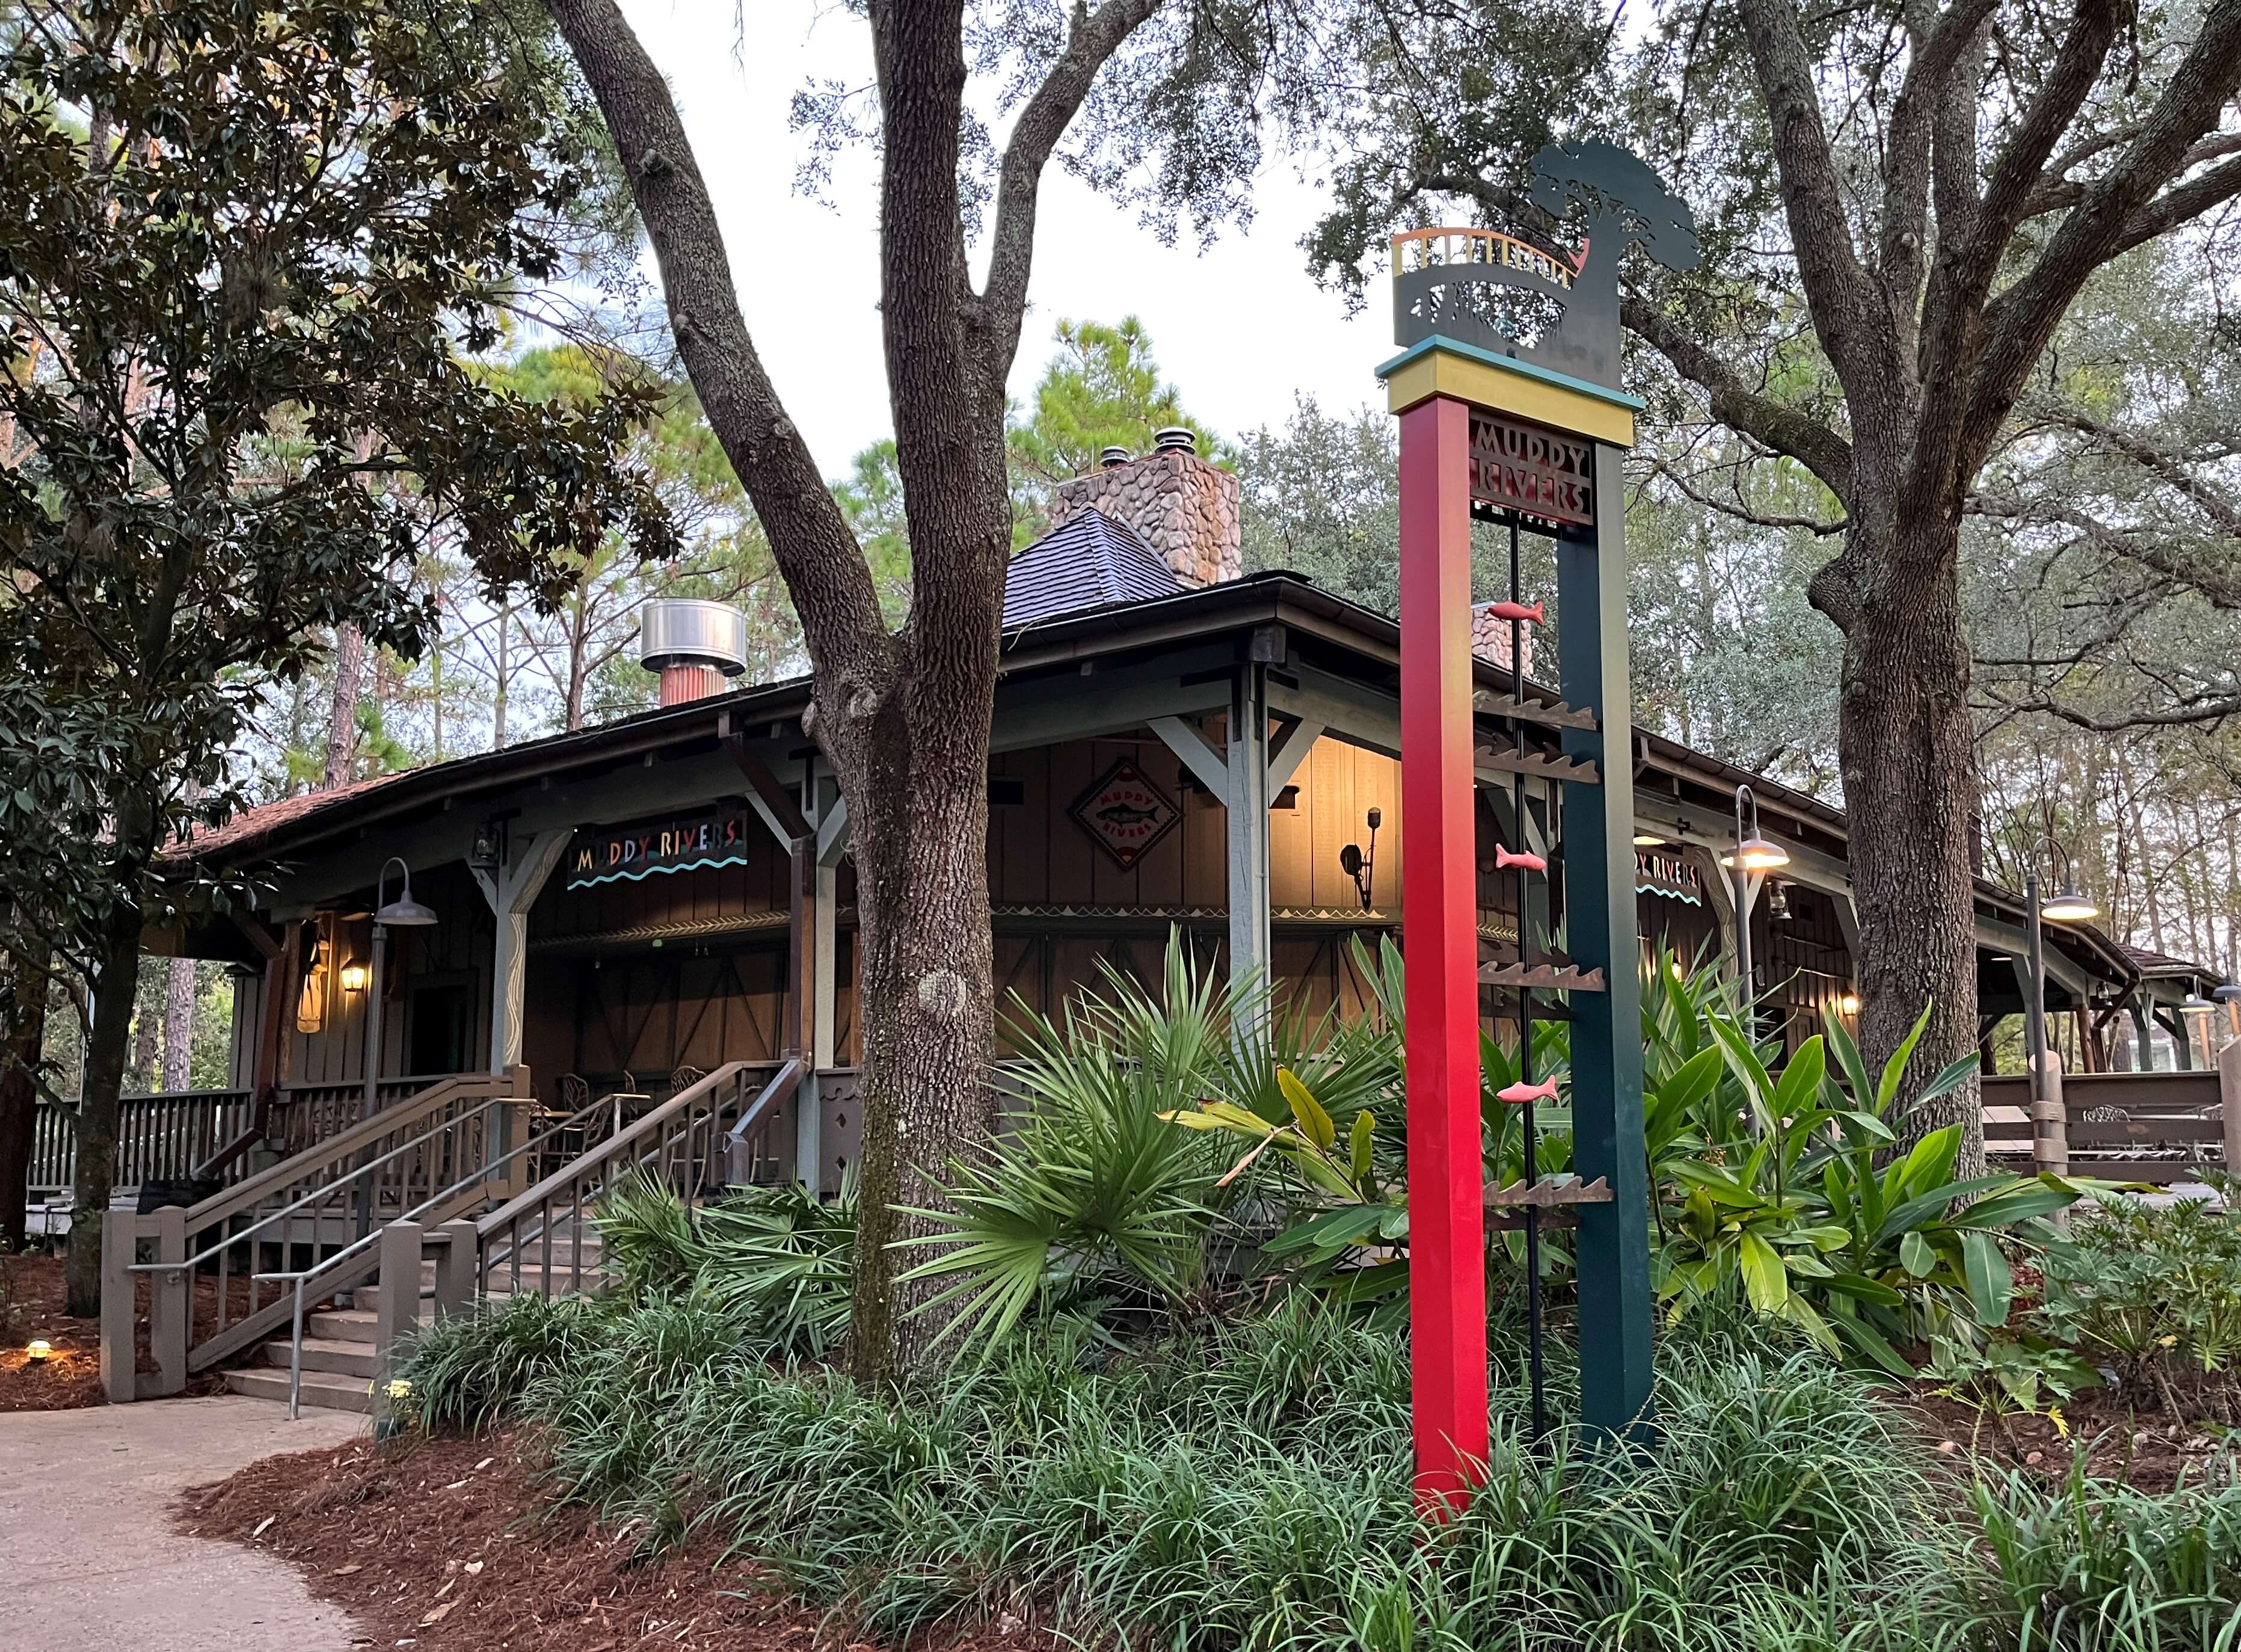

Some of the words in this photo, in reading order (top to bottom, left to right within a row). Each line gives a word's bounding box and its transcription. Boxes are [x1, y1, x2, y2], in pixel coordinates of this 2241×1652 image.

[1473, 421, 1585, 479] MUDDY
[1478, 463, 1584, 513] RIVERS
[1100, 791, 1153, 806] MUDDY
[577, 836, 653, 872] MUDDY
[660, 818, 736, 858] RIVERS
[1102, 822, 1152, 838] RIVERS
[1653, 855, 1697, 888] RIVERS
